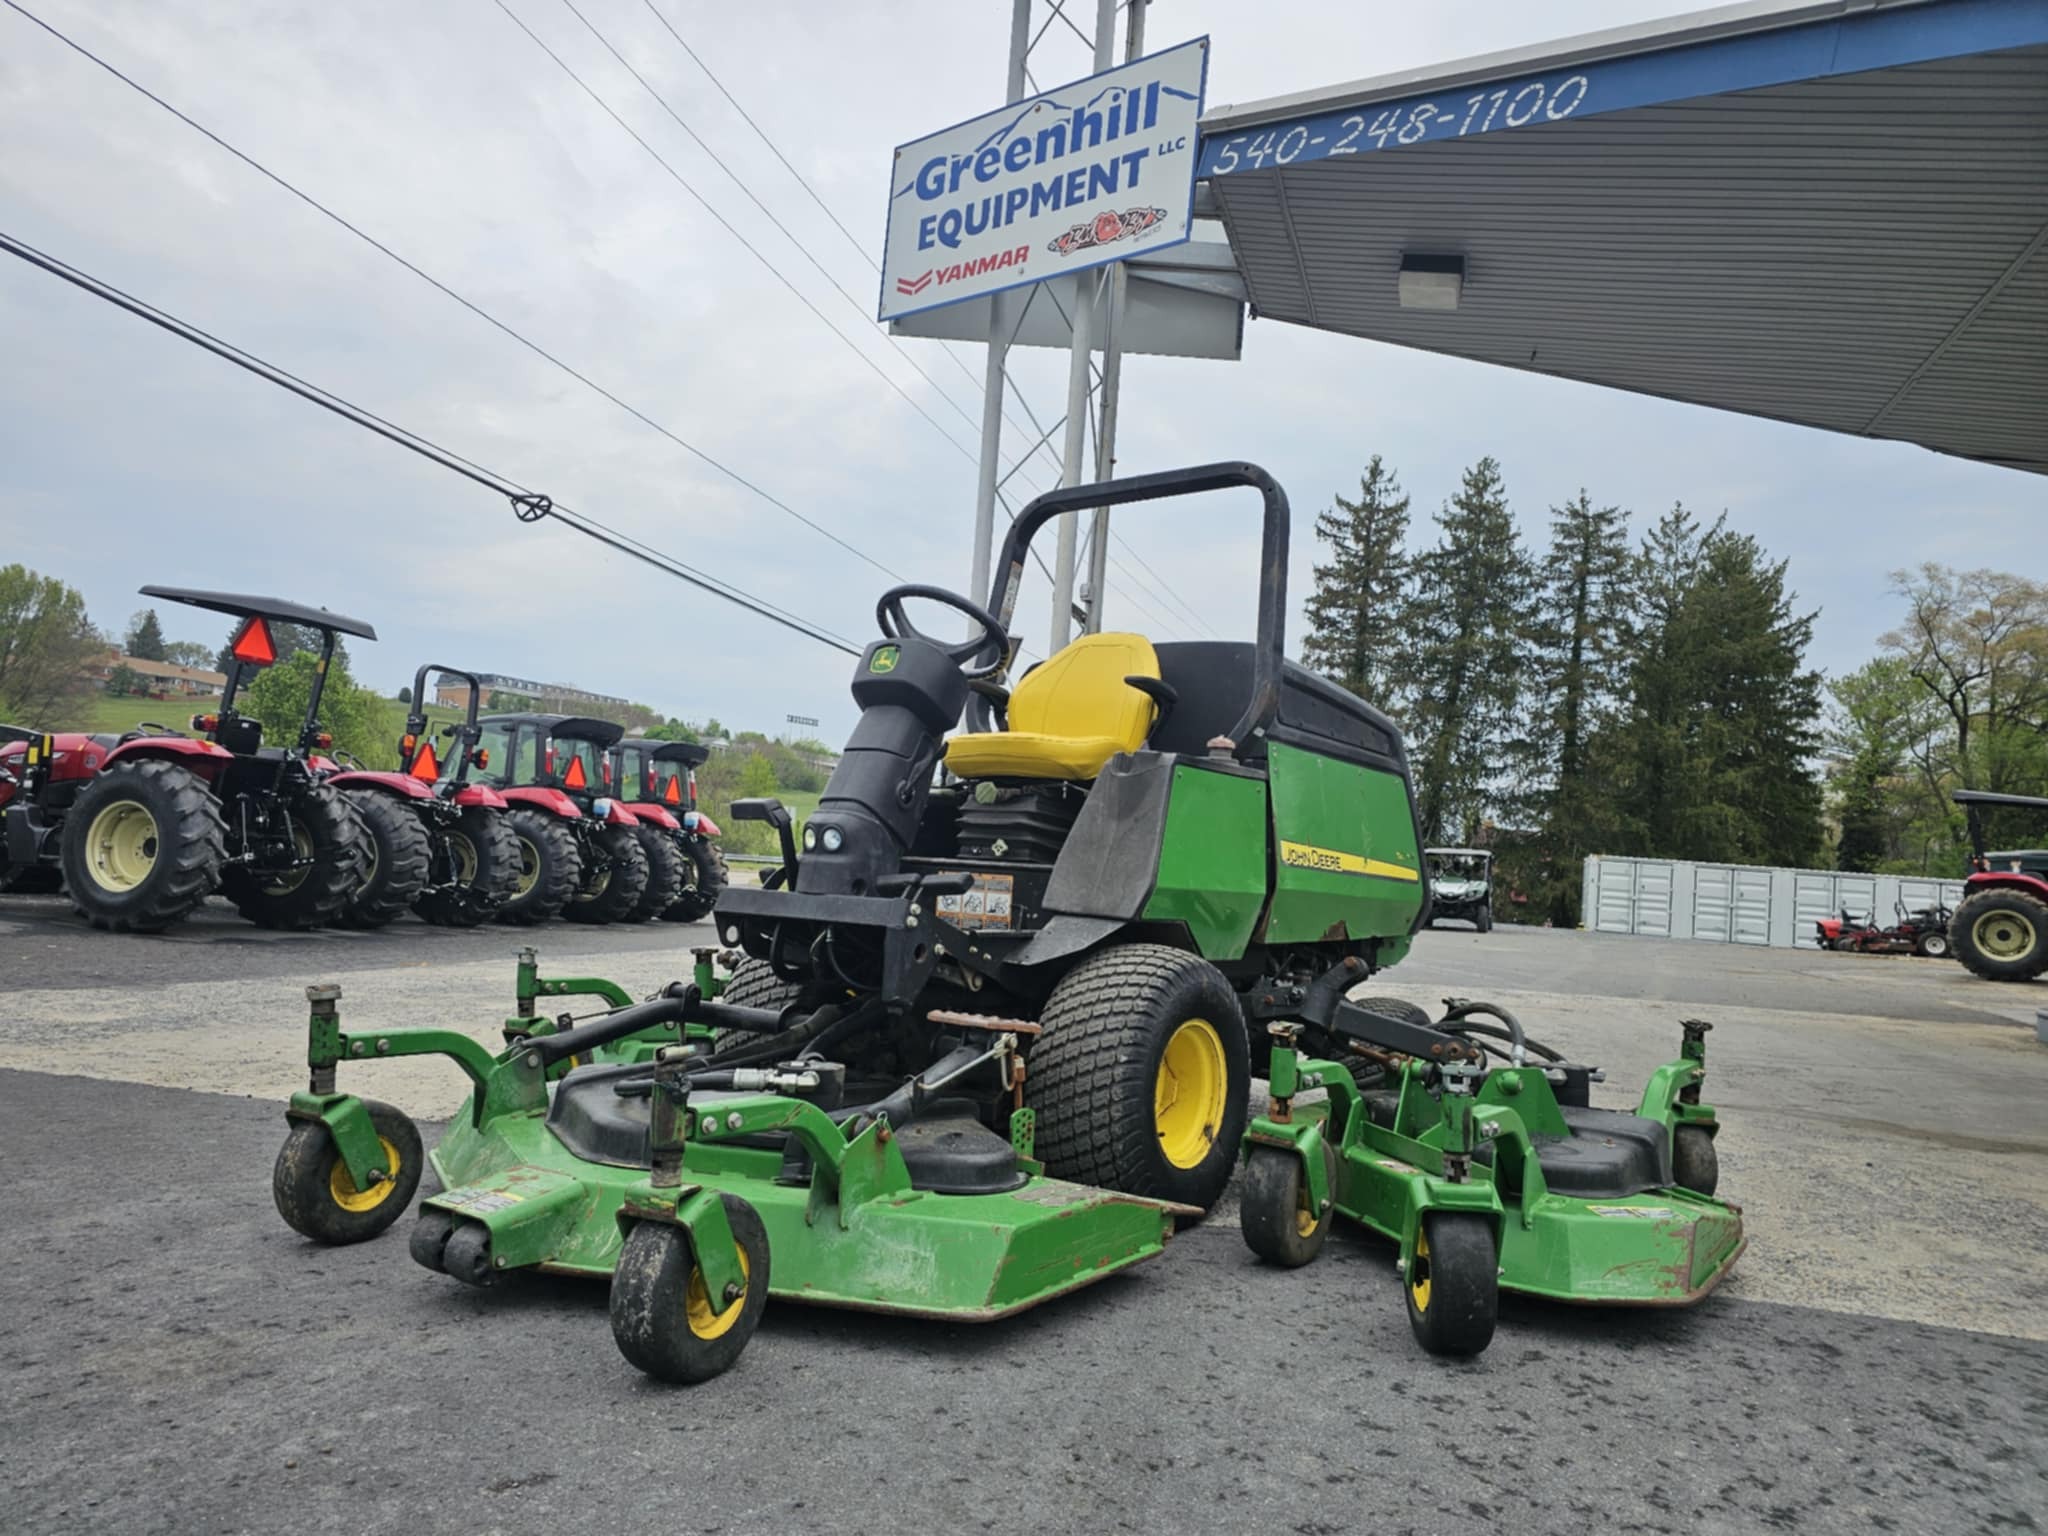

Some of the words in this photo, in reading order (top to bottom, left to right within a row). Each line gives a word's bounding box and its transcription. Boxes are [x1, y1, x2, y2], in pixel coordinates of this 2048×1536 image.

[915, 80, 1161, 201] Greenhill
[1158, 136, 1186, 156] LLC
[1212, 75, 1588, 175] 540-248-1100
[918, 147, 1150, 251] EQUIPMENT
[935, 245, 1030, 286] YANMAR
[1286, 848, 1311, 866] JOHN
[1311, 849, 1342, 869] DEERE
